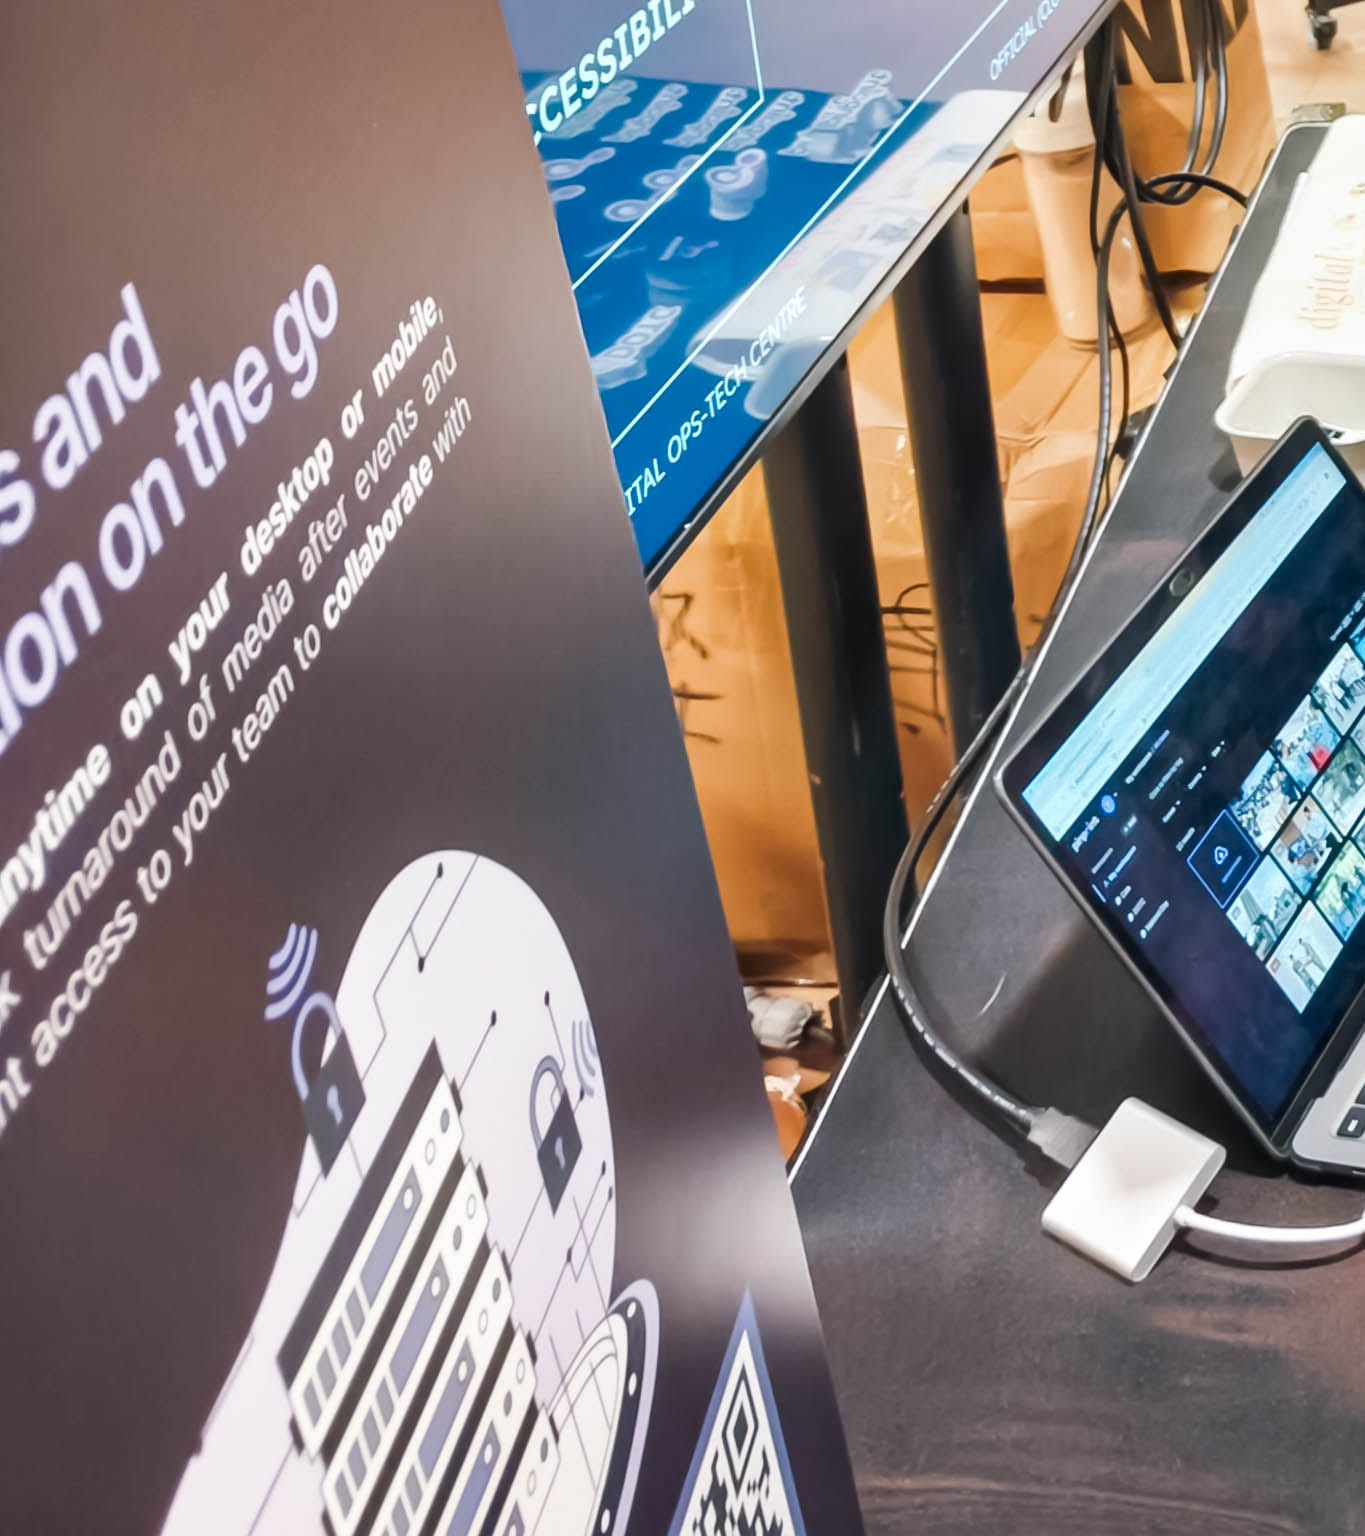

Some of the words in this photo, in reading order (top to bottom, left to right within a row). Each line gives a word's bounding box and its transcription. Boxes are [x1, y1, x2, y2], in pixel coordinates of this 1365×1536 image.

[987, 11, 1039, 81] OFFICIAL
[0, 560, 103, 755] ion
[98, 458, 186, 592] on
[174, 345, 274, 491] the
[272, 263, 339, 401] go
[0, 743, 112, 927] nytime
[119, 674, 164, 741] on
[168, 572, 232, 686] your
[239, 436, 334, 578] desktop
[339, 387, 366, 440] or
[372, 293, 445, 399] mobile,
[33, 282, 162, 491] and
[624, 458, 666, 516] ITAL
[667, 356, 748, 463] OPS-TECH
[749, 286, 808, 365] CENTRE
[23, 731, 183, 970] turnaround
[187, 673, 219, 742] of
[221, 577, 295, 690] media
[296, 495, 350, 584] after
[354, 397, 419, 503] events
[421, 335, 458, 408] and
[29, 899, 140, 1069] access
[137, 848, 172, 904] to
[172, 753, 233, 867] your
[231, 662, 296, 764] team
[294, 623, 322, 673] to
[323, 454, 434, 632] collaborate
[431, 394, 472, 470] with
